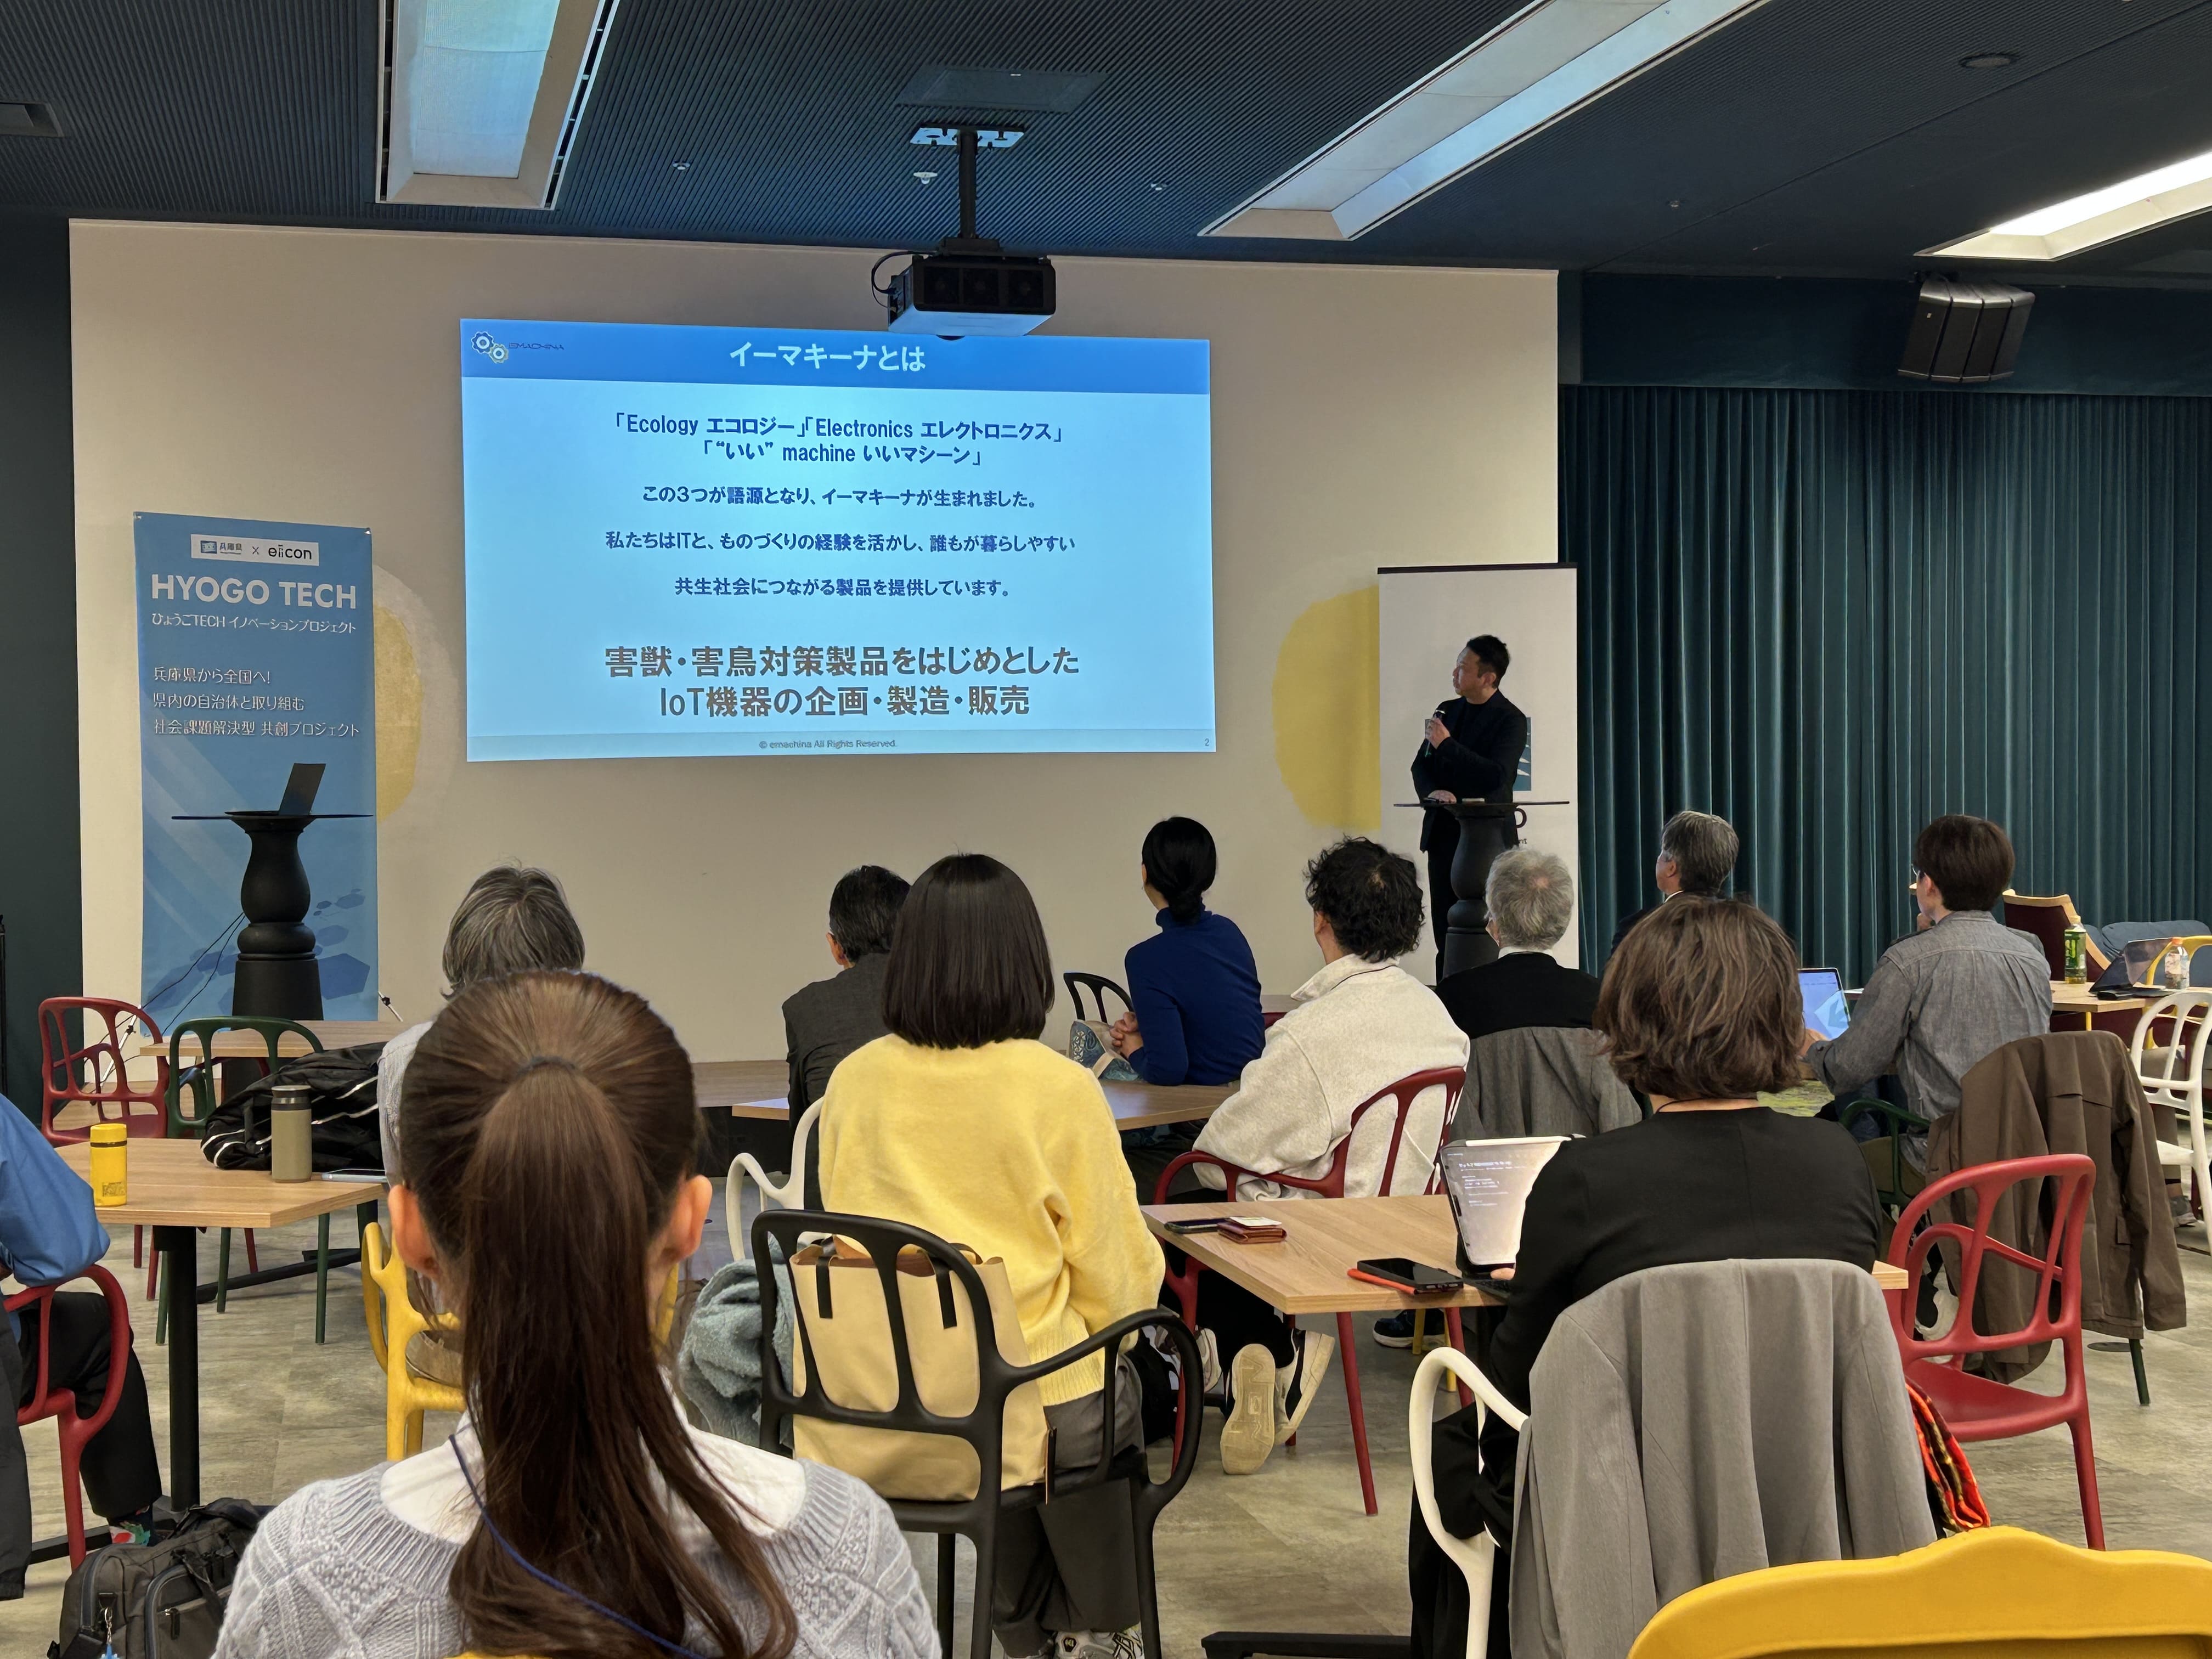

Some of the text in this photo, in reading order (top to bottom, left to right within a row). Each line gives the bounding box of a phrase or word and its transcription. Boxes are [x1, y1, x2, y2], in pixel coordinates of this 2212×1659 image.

[729, 341, 926, 373] イーマキーナとは
[782, 443, 856, 462] machine
[151, 574, 356, 610] HYOGO TECH
[675, 577, 1009, 598] 共生社会につながる製品を提供しています。
[605, 645, 1080, 677] 害獣・害鳥対策製品をはじめとした
[660, 685, 1030, 718] IoT機器の企画・製造・販売
[154, 719, 360, 738] 社会課題解決型 共創プロジェクト
[827, 740, 854, 749] Rights
[1204, 738, 1210, 747] 2
